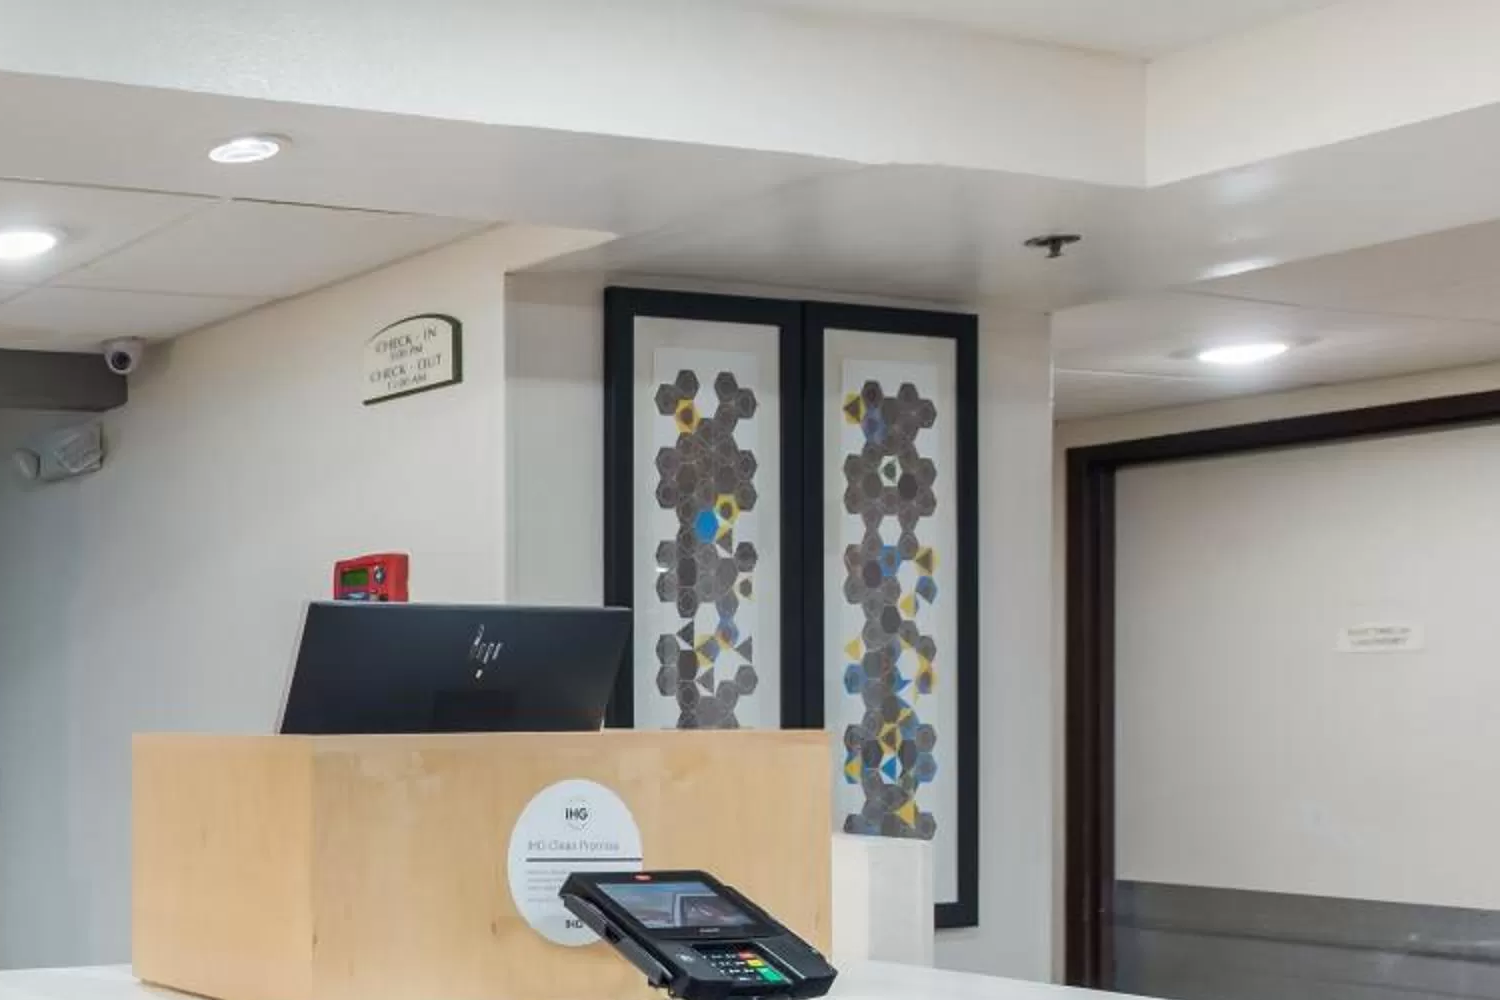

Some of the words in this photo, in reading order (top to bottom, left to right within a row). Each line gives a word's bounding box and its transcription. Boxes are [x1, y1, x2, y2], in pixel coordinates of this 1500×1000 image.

[374, 335, 412, 353] CHECK
[423, 325, 437, 341] IN
[369, 364, 406, 383] CHECK
[417, 352, 442, 369] OUT
[565, 807, 588, 820] IHG
